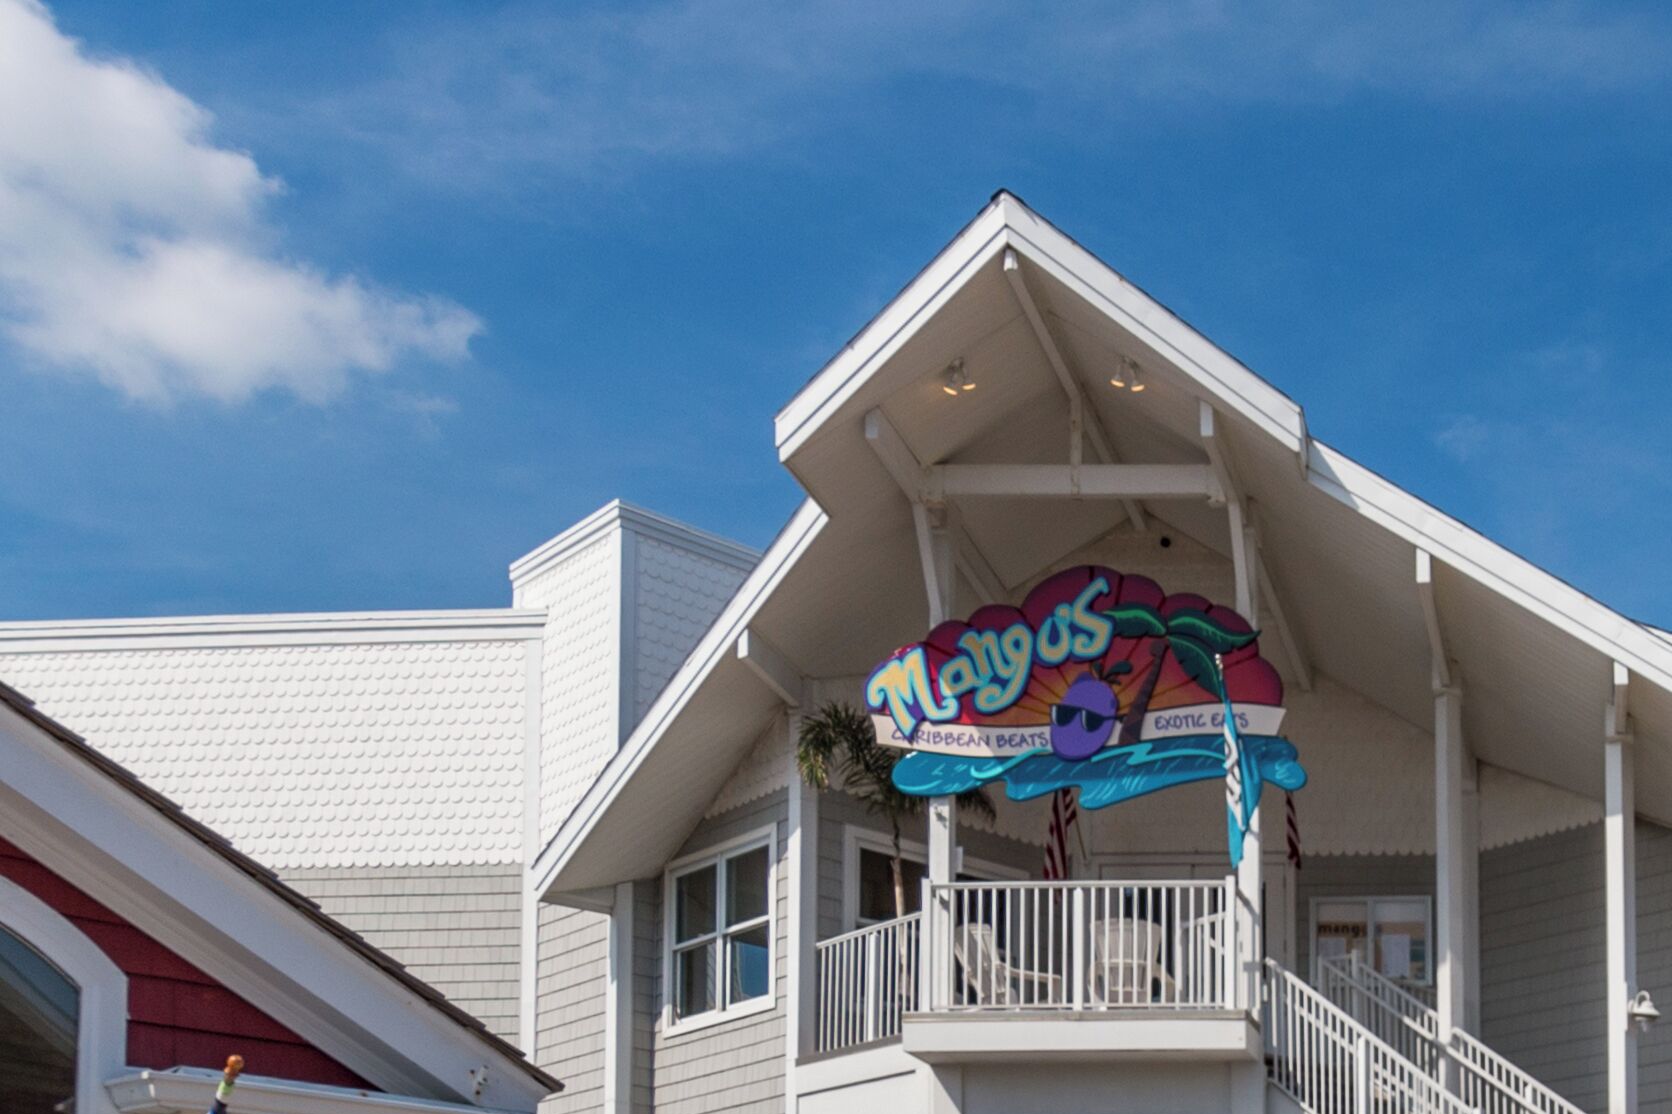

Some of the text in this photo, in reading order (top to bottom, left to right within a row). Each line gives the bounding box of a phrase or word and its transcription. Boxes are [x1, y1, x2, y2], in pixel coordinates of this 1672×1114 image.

[1154, 713, 1206, 731] EXOTIC
[891, 728, 1048, 749] CRIBBEAN BEATS
